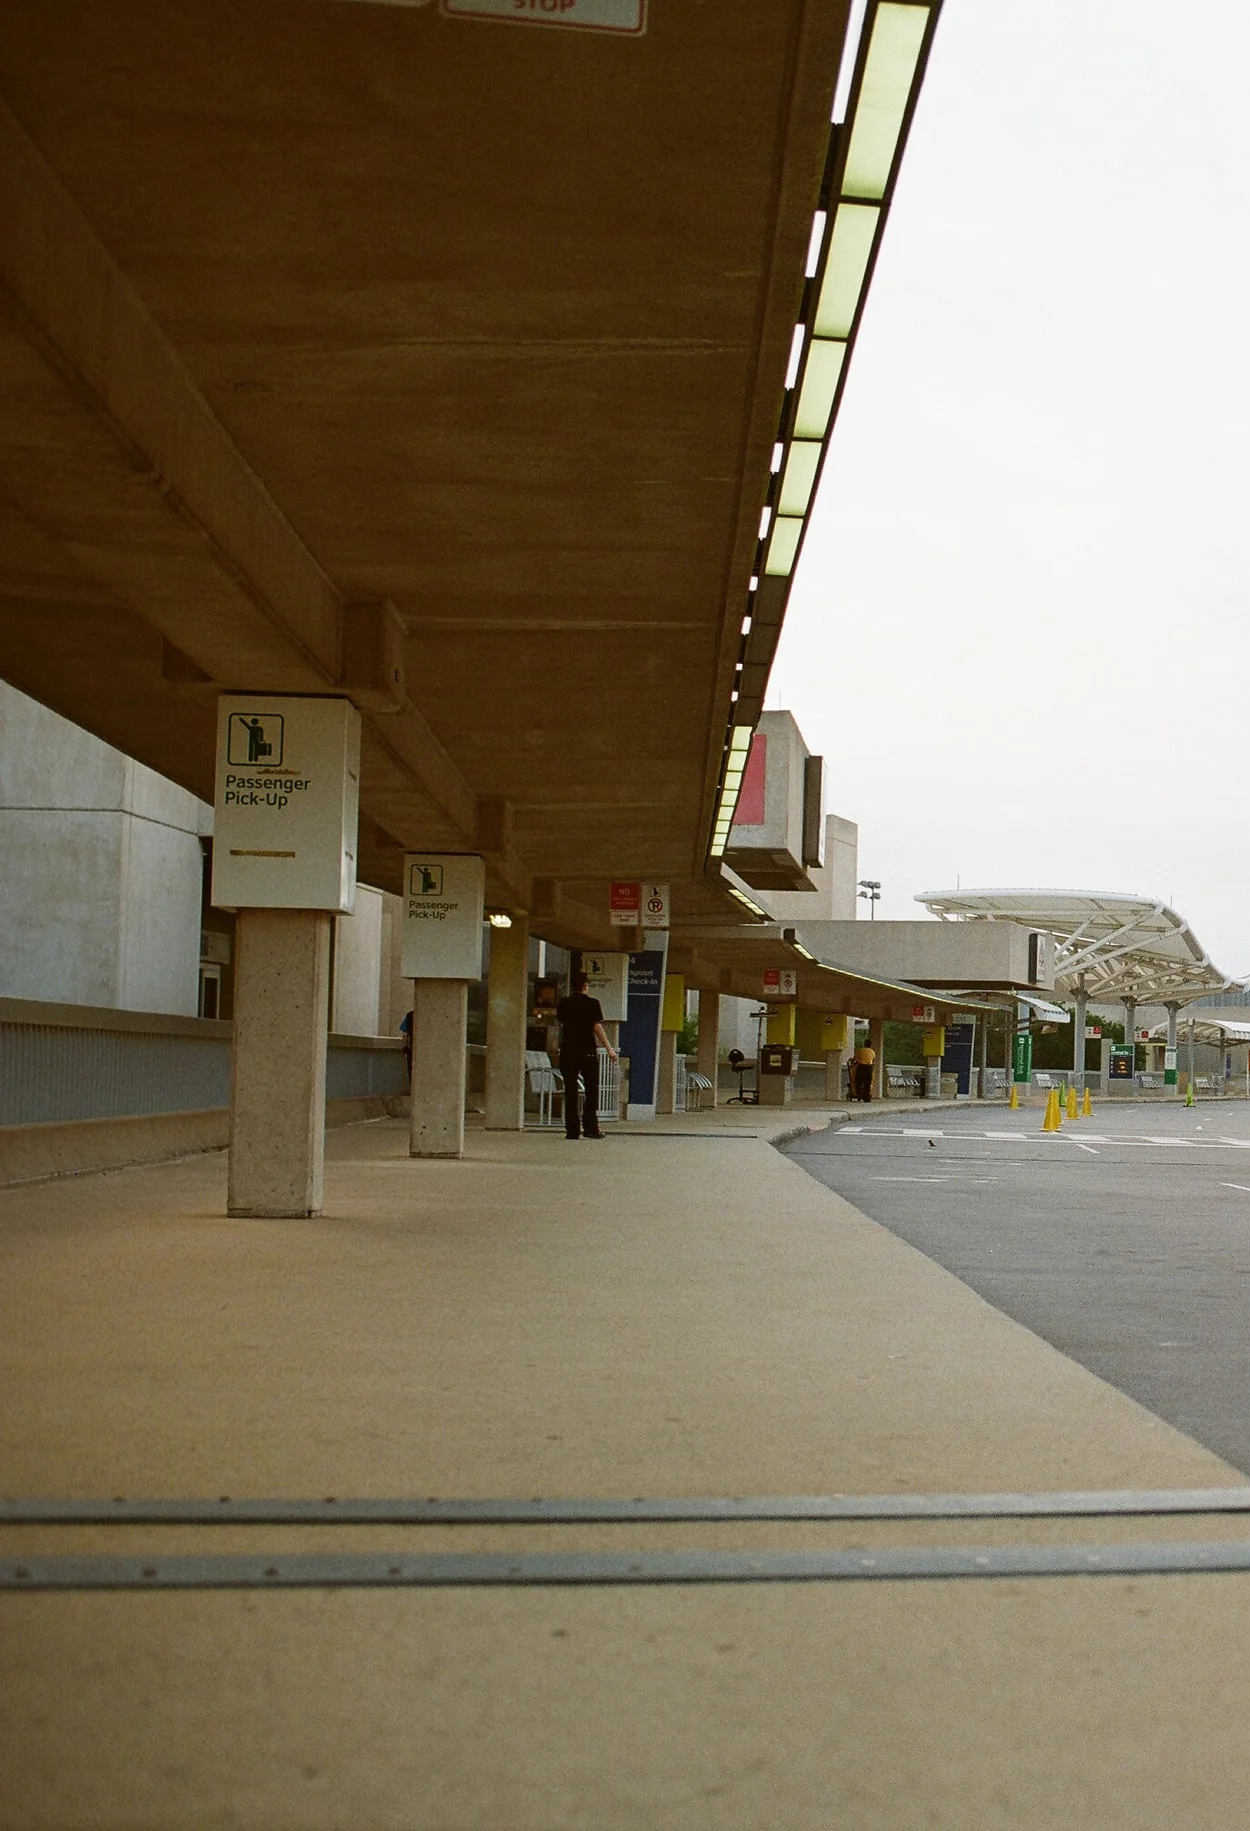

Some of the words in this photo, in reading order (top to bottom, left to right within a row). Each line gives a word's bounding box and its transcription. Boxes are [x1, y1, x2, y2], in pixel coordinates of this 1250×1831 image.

[225, 774, 311, 793] Passenger
[225, 791, 288, 810] Pick-Up
[409, 900, 458, 912] Passenger
[409, 910, 446, 920] Pick-Up
